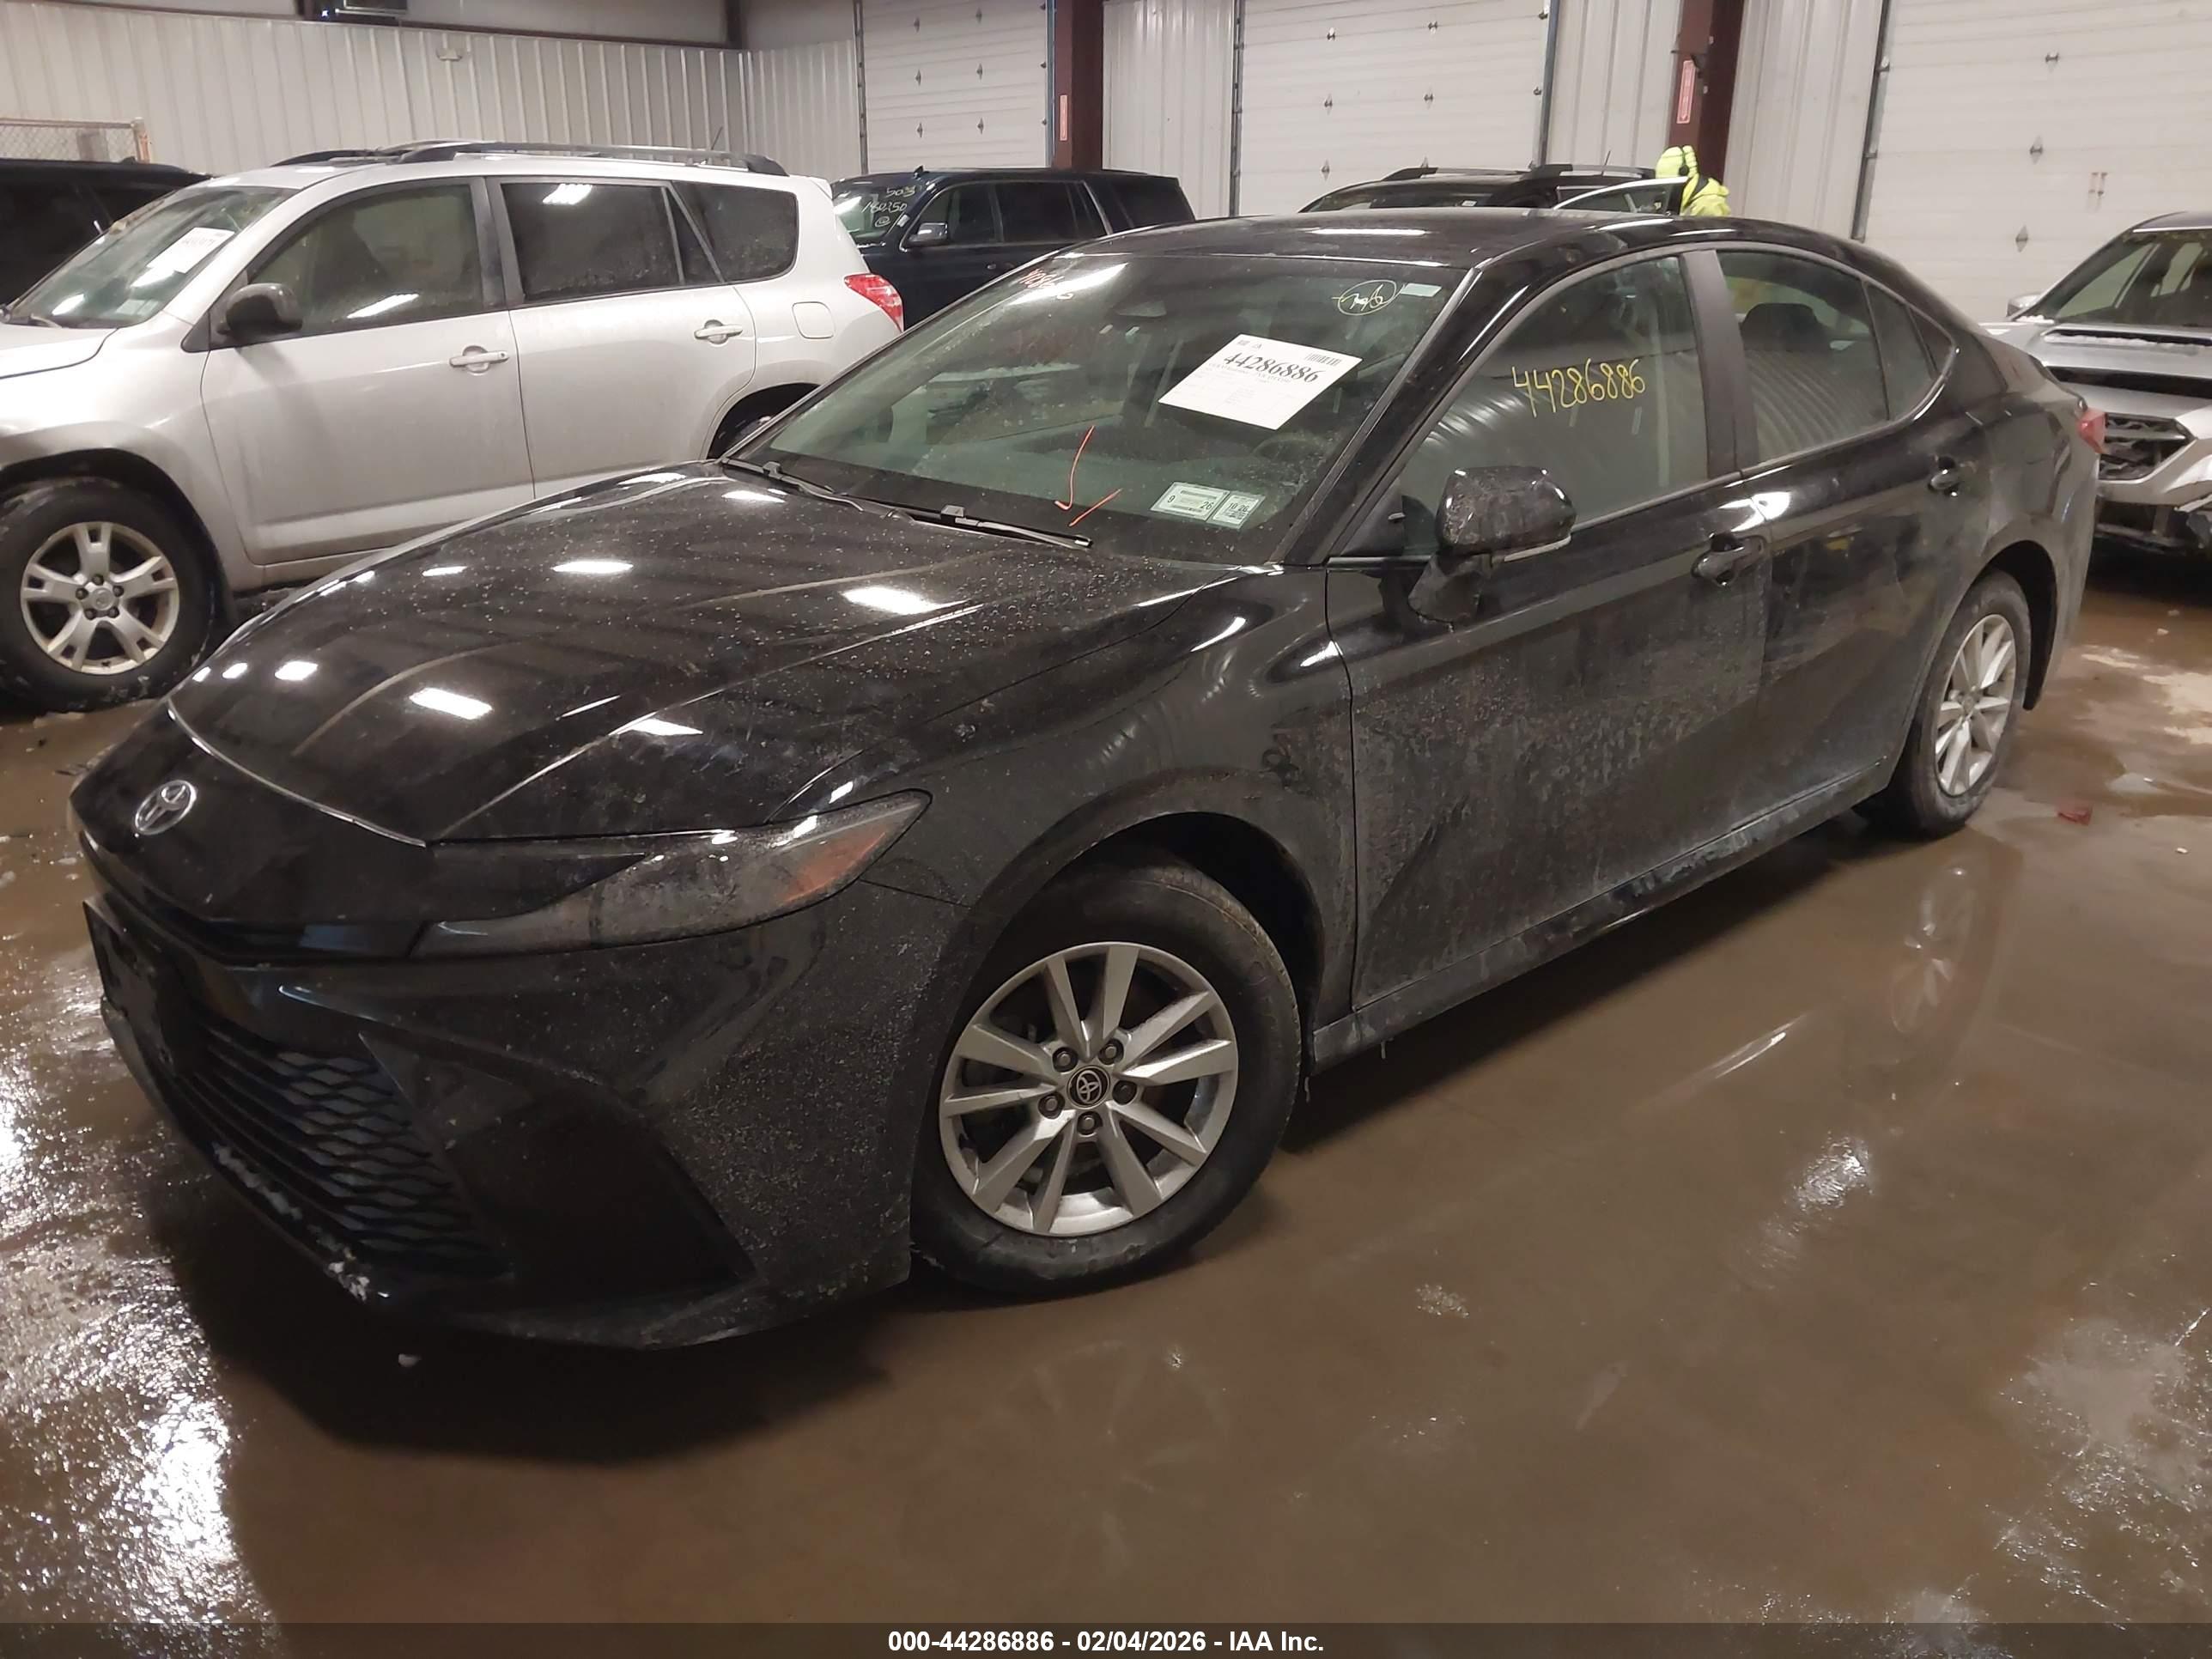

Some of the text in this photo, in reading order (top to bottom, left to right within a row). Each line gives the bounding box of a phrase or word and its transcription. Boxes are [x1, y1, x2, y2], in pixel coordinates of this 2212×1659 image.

[1224, 351, 1326, 383] 44286886
[1511, 357, 1645, 418] 44286886
[1200, 501, 1214, 510] 26
